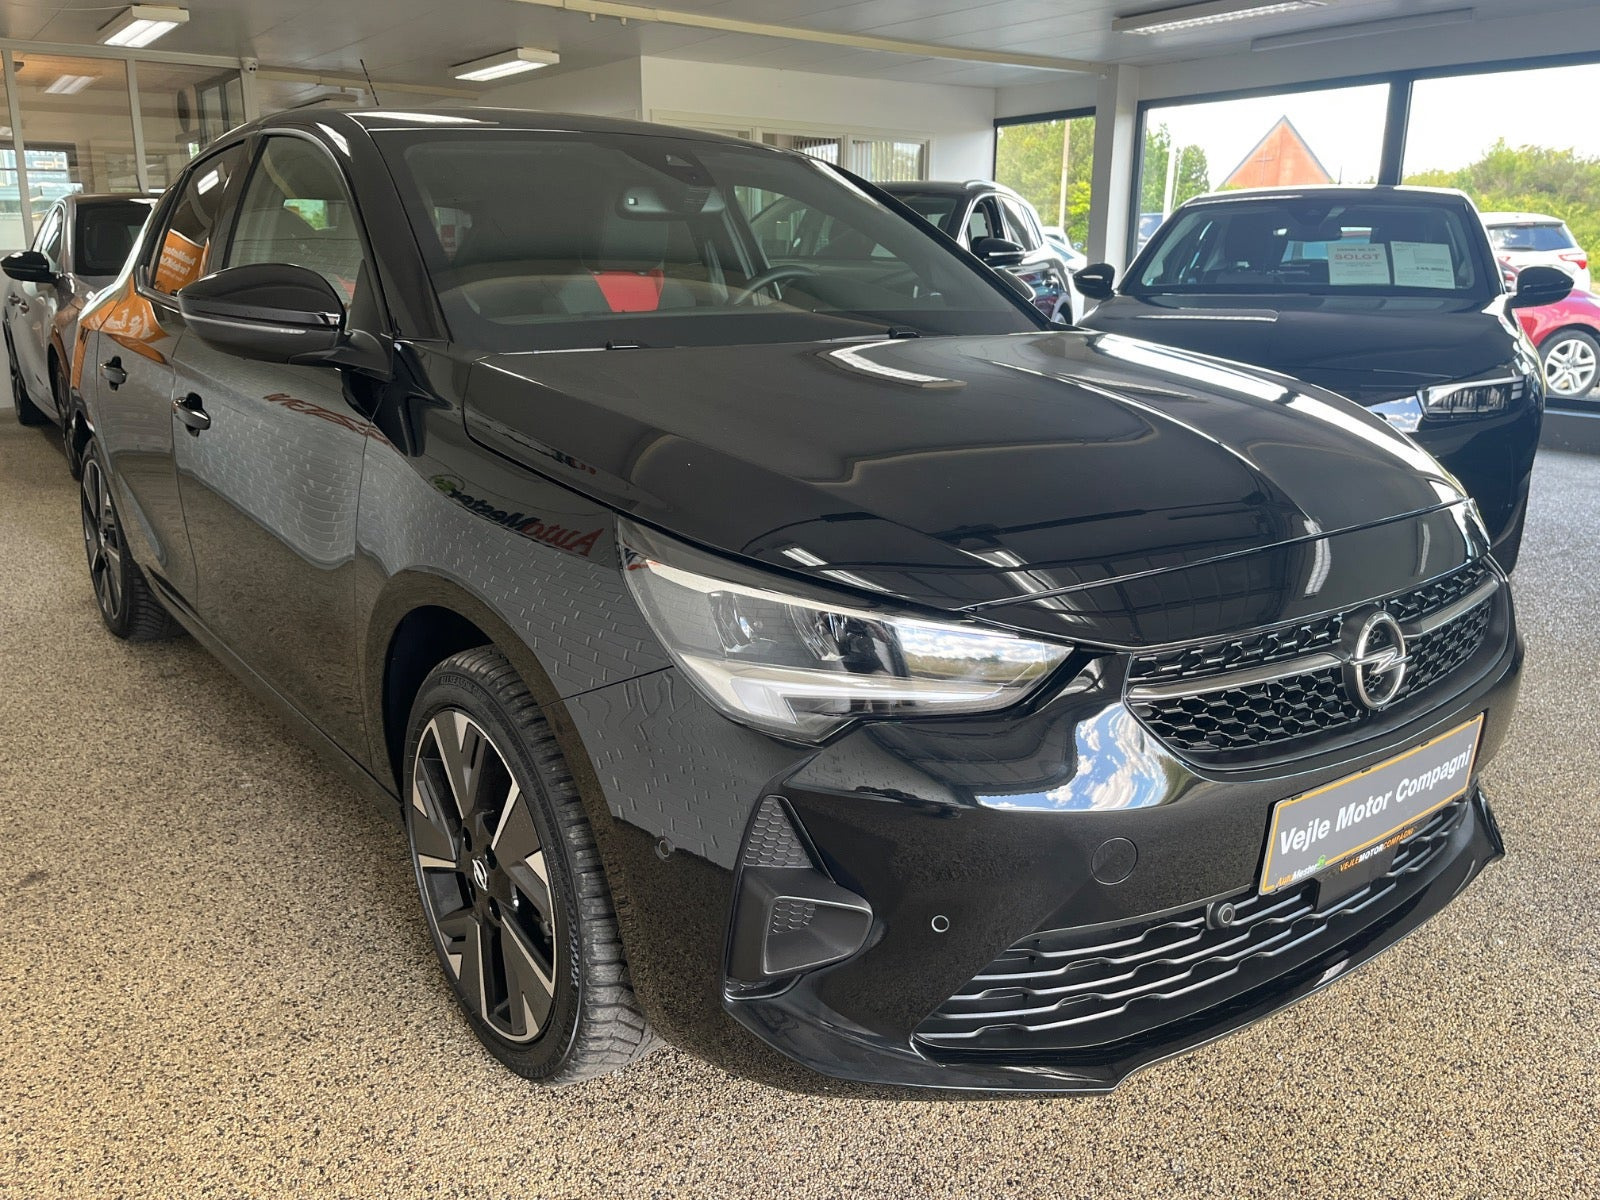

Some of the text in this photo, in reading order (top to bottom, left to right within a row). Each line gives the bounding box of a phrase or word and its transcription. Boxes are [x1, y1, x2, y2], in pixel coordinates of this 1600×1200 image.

[1280, 744, 1473, 855] Vejle Motor Compagni
[1276, 863, 1319, 887] AutoMester
